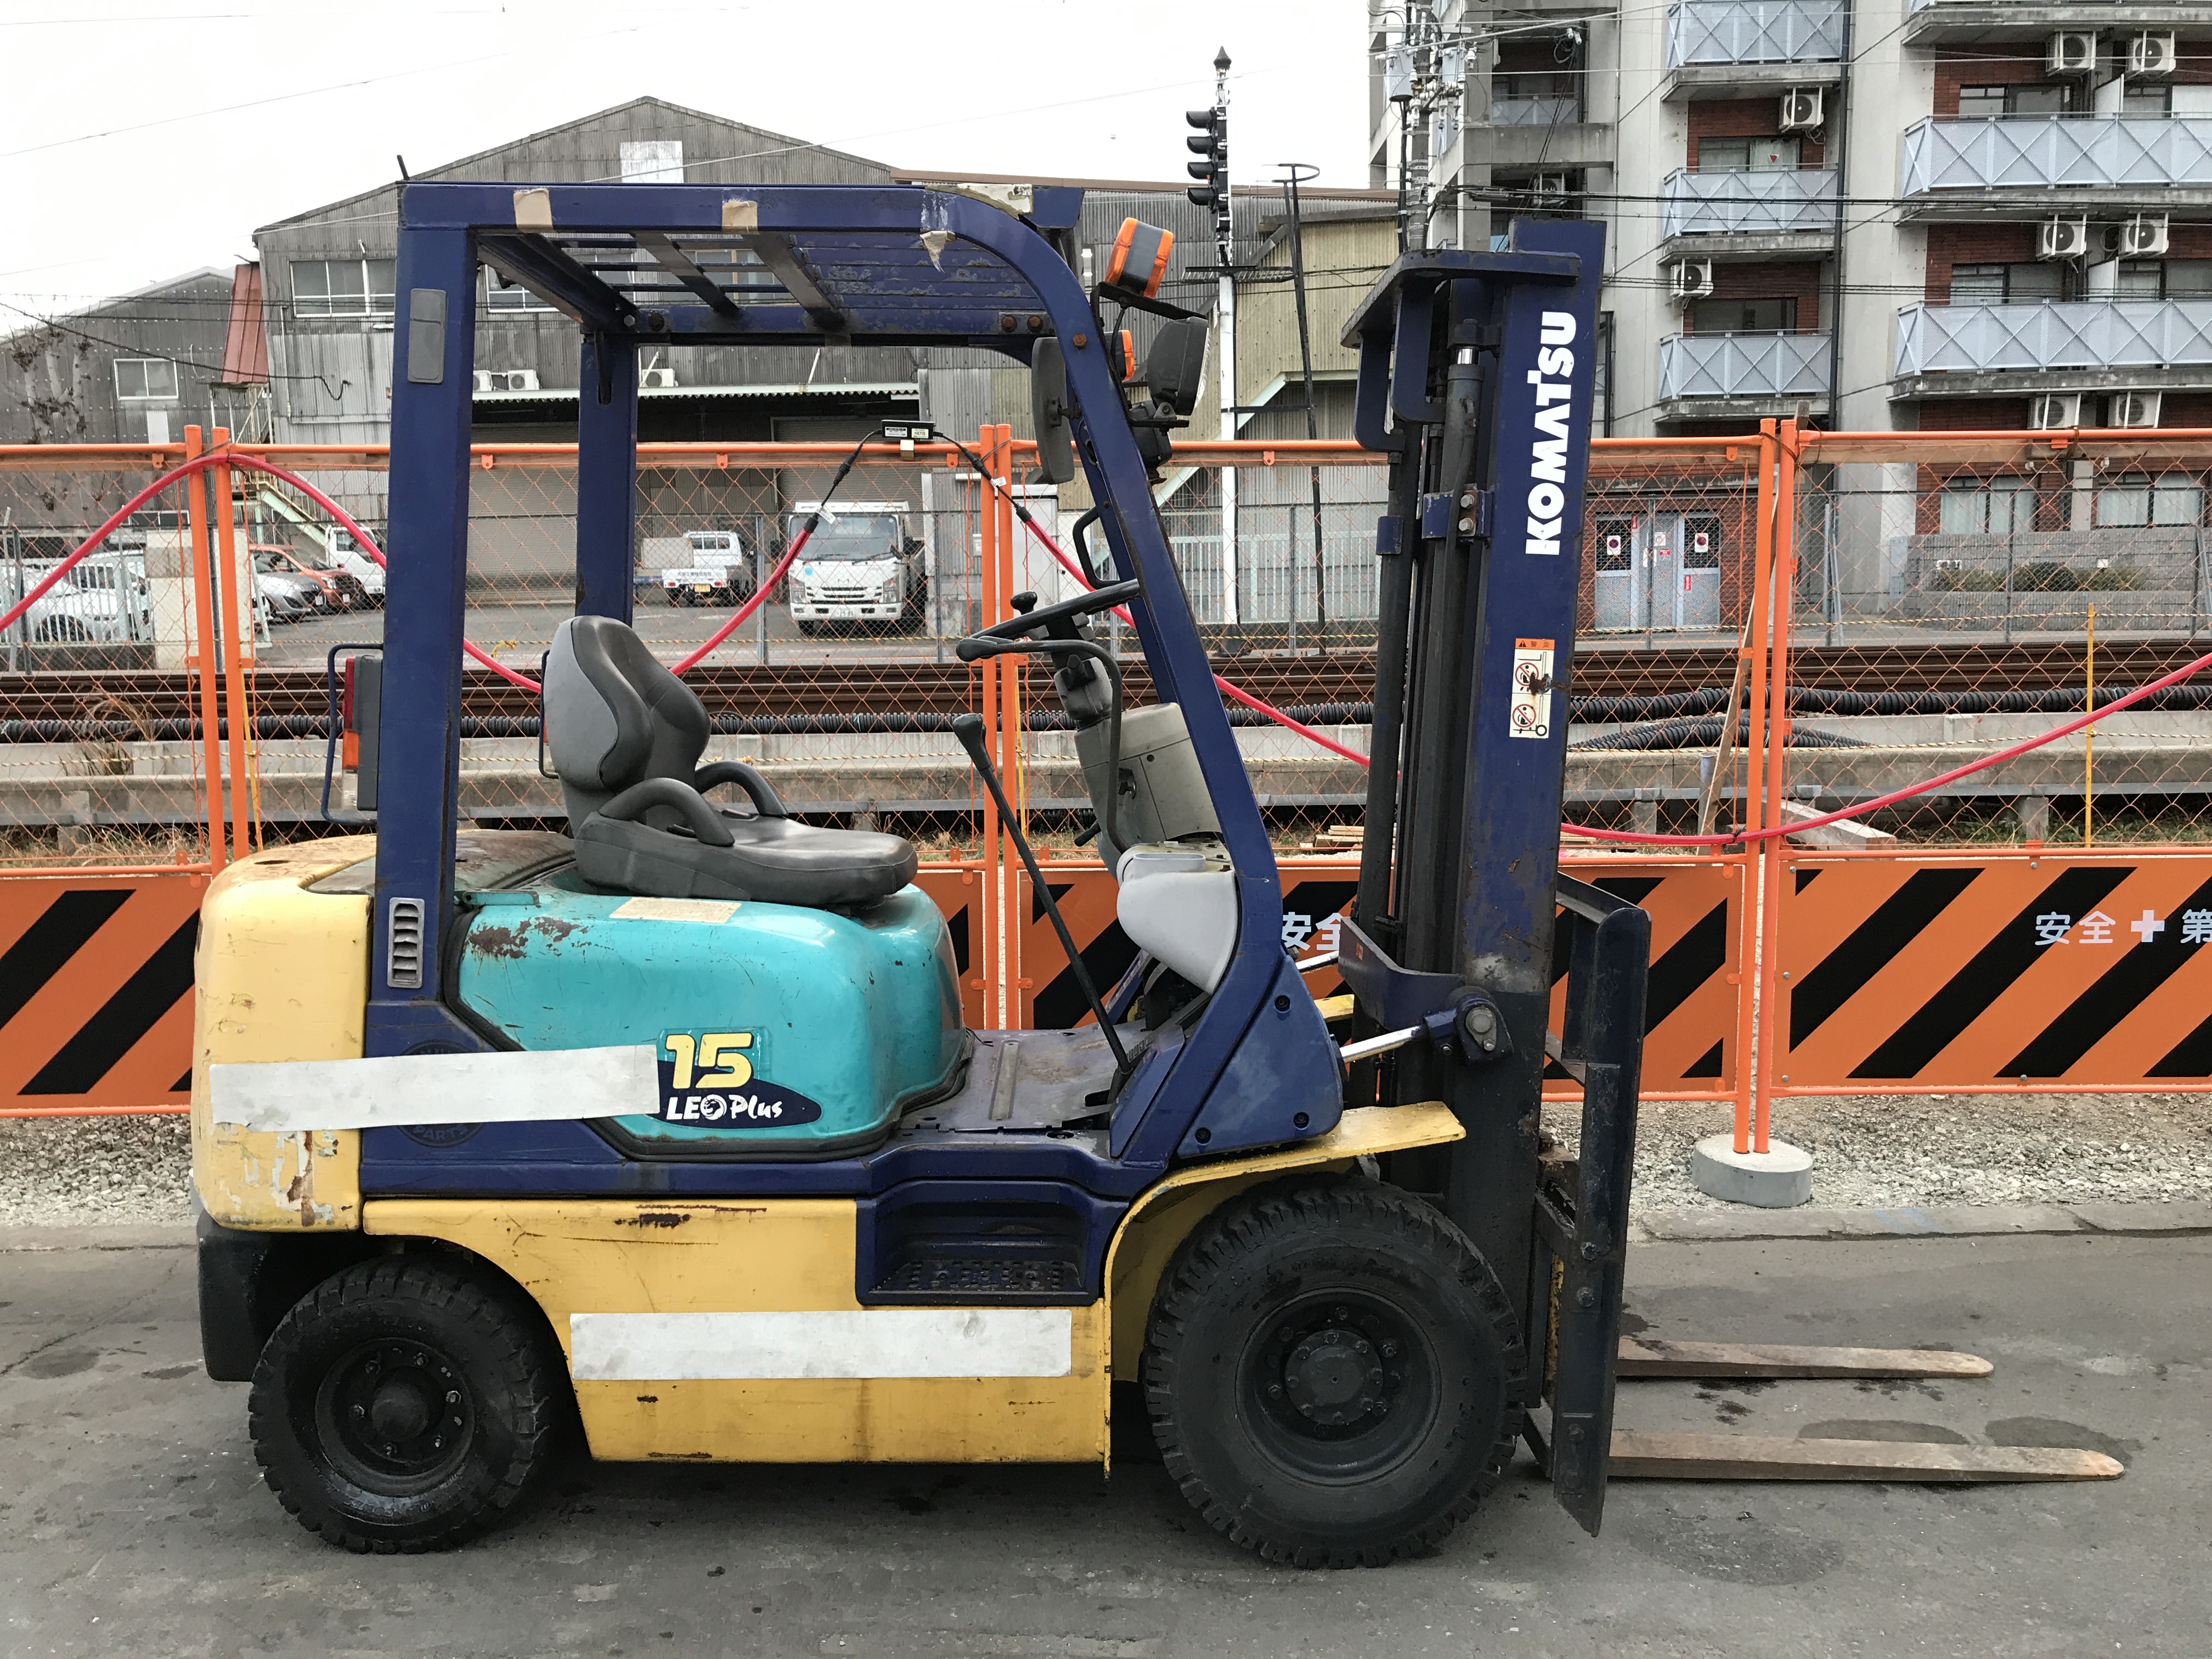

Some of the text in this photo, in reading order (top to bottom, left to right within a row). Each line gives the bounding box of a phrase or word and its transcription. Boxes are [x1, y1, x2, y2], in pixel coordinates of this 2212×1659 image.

[1392, 76, 1401, 85] 20
[1525, 311, 1577, 555] KOMATSU
[1282, 911, 1342, 951] 安全
[2034, 908, 2212, 946] 安全 第
[665, 1032, 755, 1090] 15
[728, 1094, 783, 1120] Plus
[413, 1124, 469, 1141] PARTS
